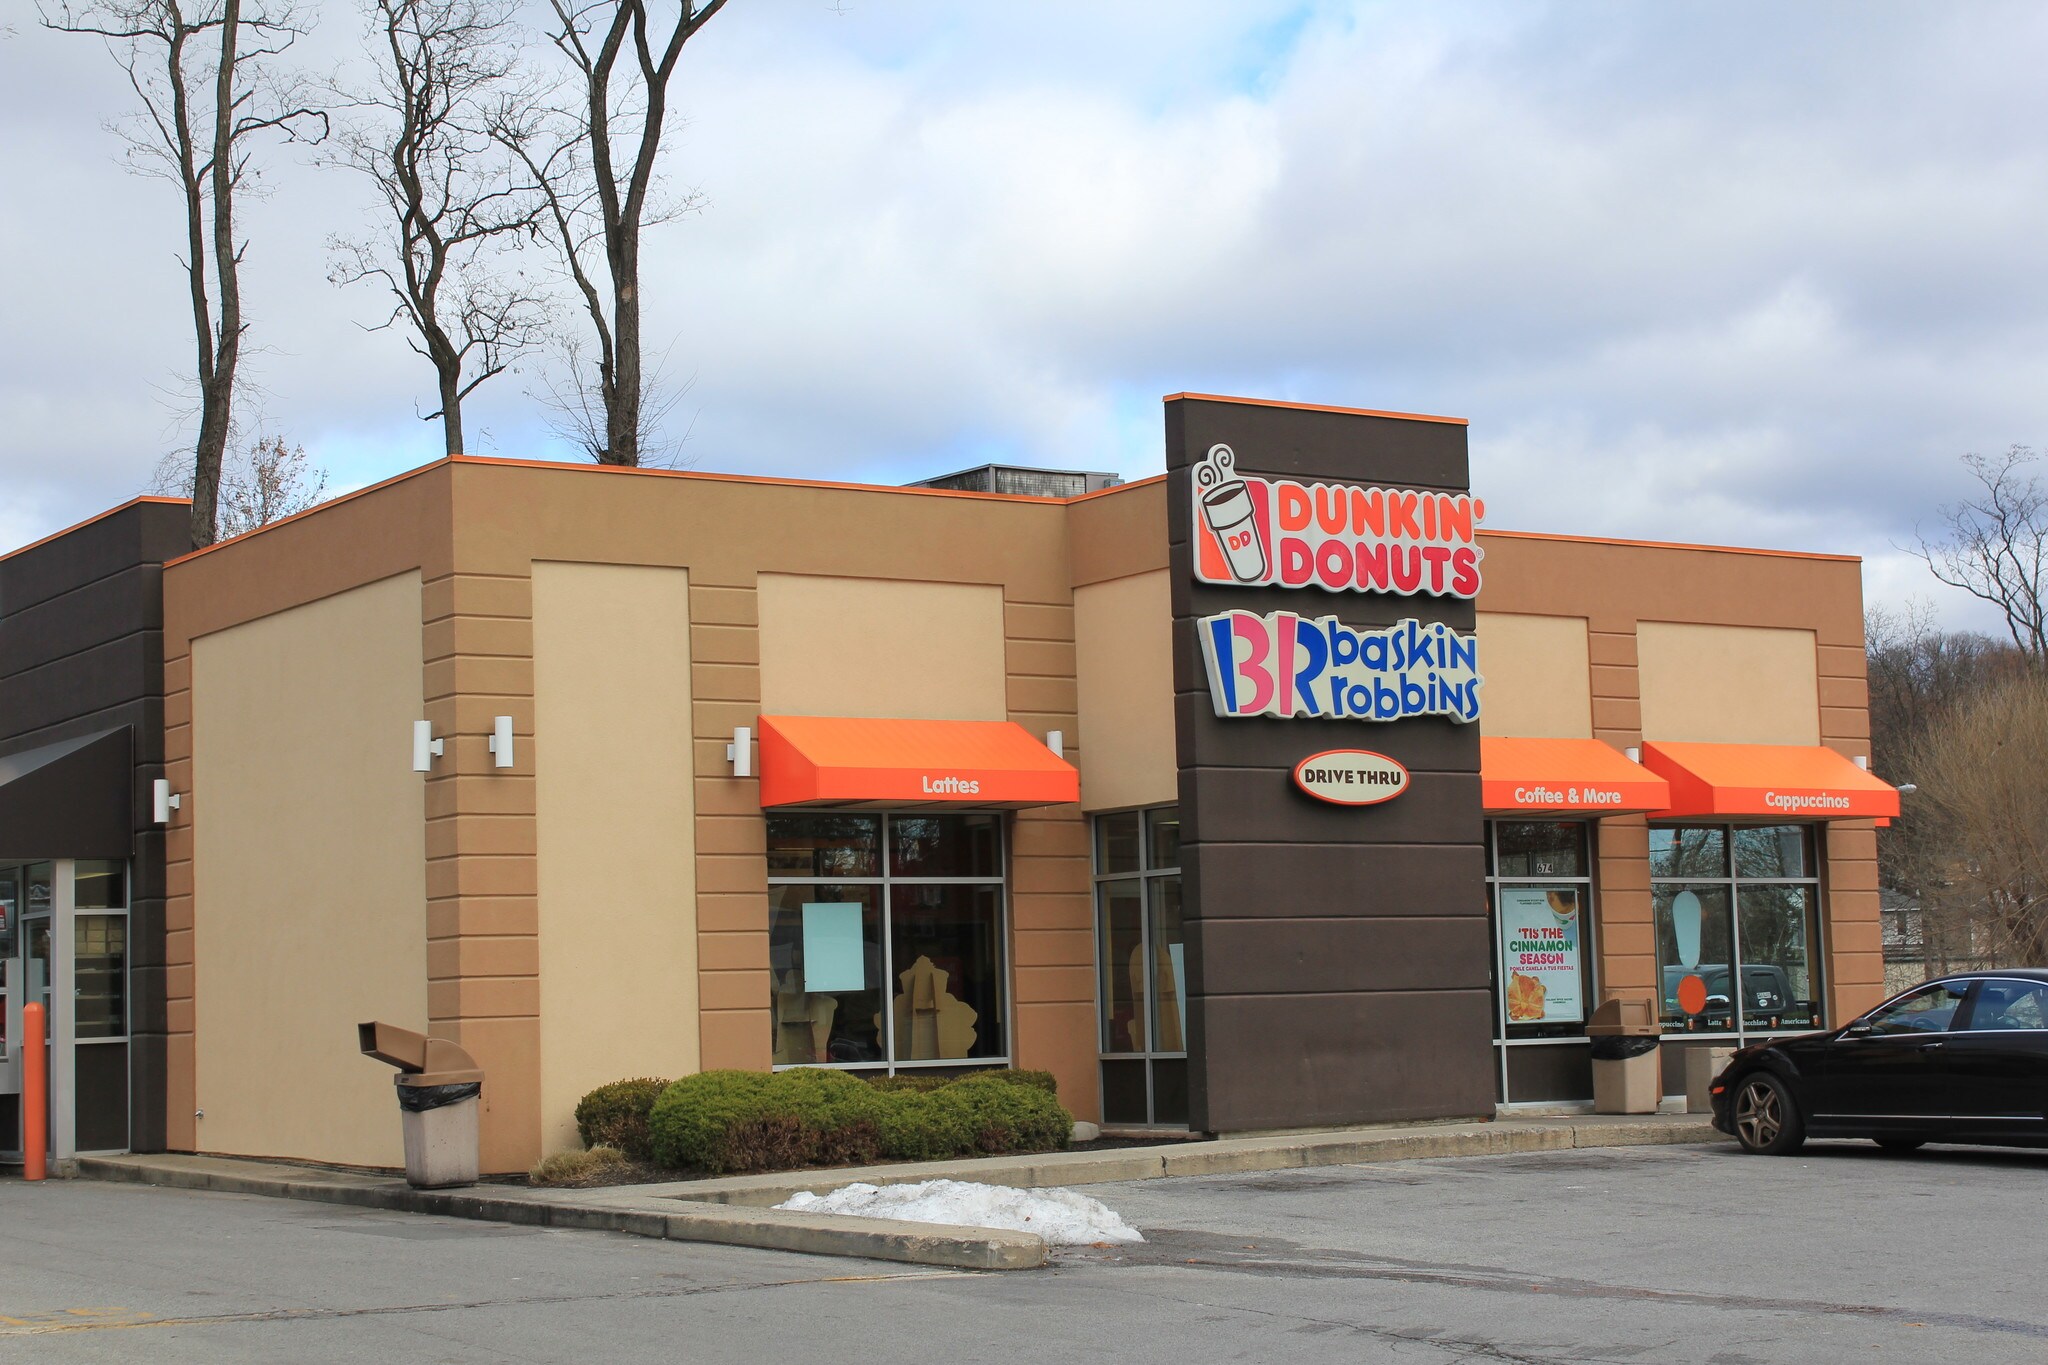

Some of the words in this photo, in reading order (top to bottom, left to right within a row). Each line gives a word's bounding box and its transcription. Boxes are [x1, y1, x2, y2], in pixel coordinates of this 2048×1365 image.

[1278, 484, 1485, 543] DUNKIN'
[1227, 530, 1252, 551] DD
[1280, 537, 1480, 595] DONUTS
[1210, 613, 1328, 716] BR
[922, 775, 980, 794] Lattes
[1304, 769, 1354, 784] DRIVE
[1356, 770, 1401, 786] THRU
[1514, 786, 1564, 804] Coffee
[1567, 787, 1580, 804] &
[1583, 788, 1622, 804] More
[1765, 791, 1850, 812] Cappuccinos
[1537, 863, 1553, 873] 674
[1518, 927, 1539, 939] 'TIS
[1541, 927, 1564, 939] THE
[1509, 940, 1573, 952] CINNAMON
[1519, 953, 1564, 965] SEASON
